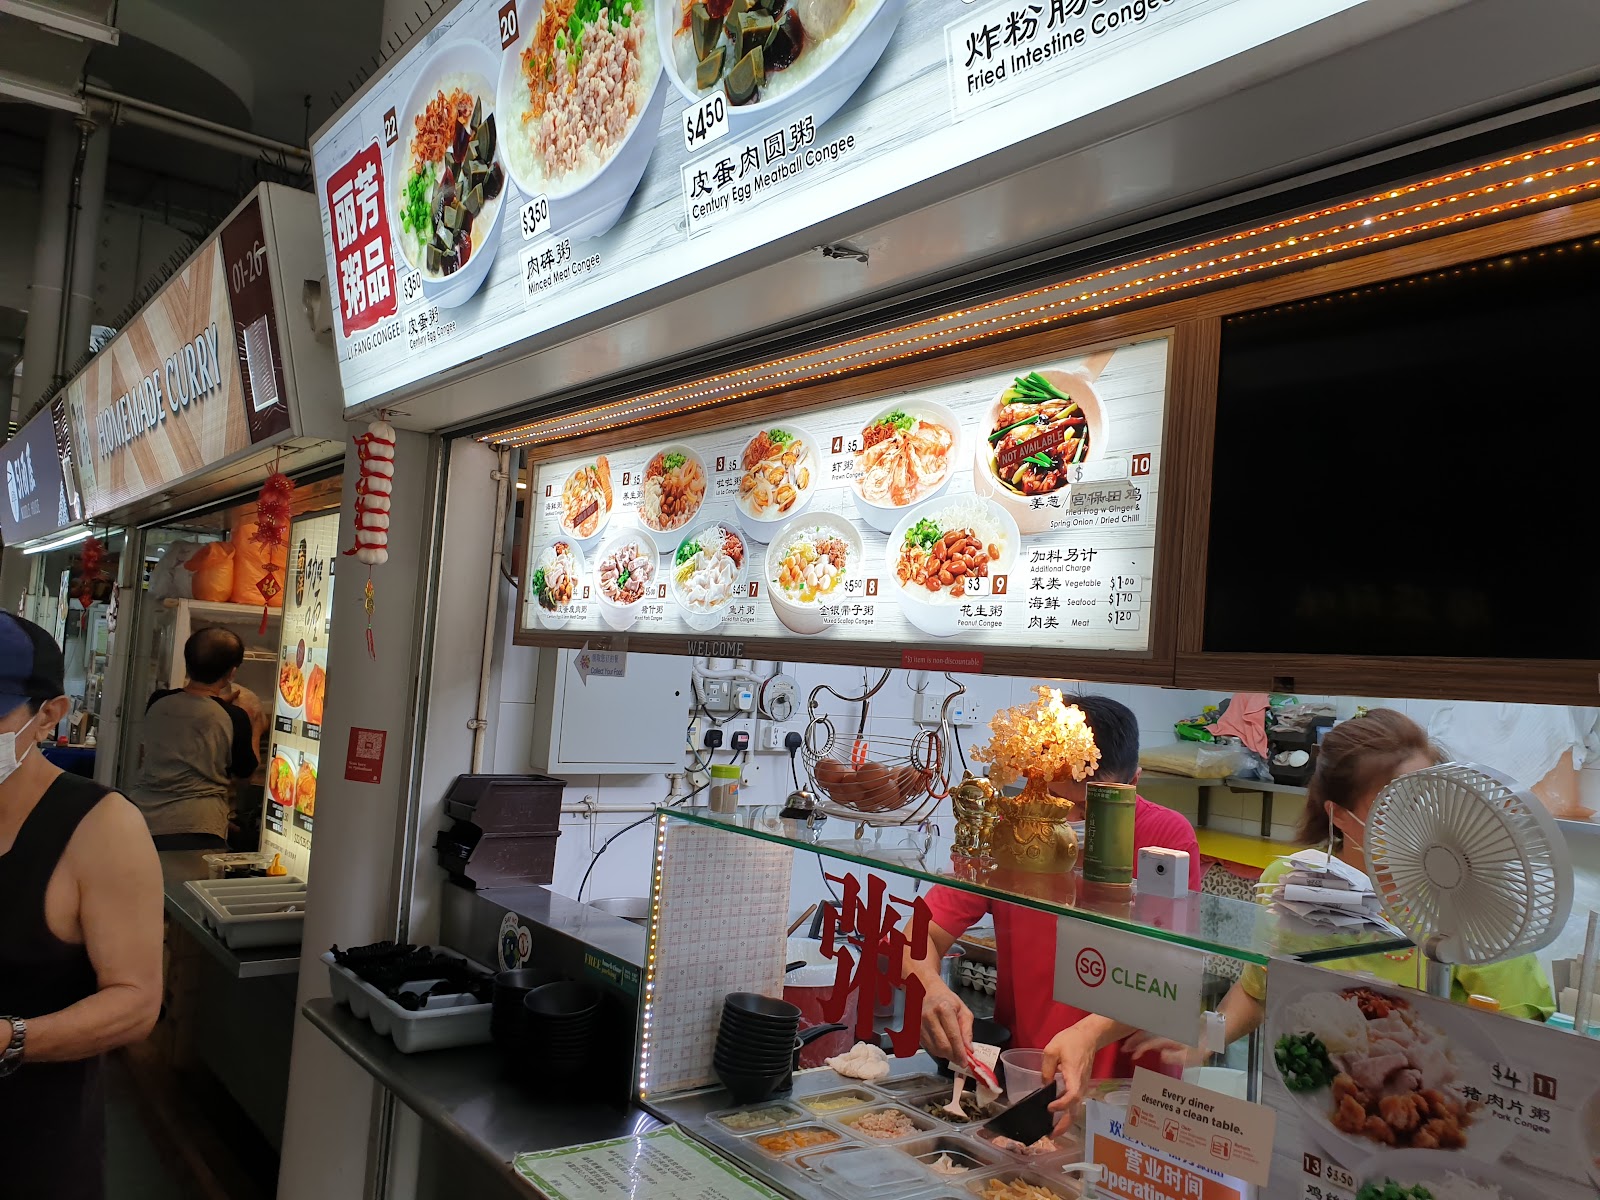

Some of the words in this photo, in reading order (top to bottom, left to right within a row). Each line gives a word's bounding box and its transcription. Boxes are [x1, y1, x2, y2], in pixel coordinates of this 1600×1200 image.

[501, 10, 517, 42] 20
[965, 0, 1101, 68] 炸粉肠
[967, 59, 1005, 93] Fried
[1010, 28, 1085, 75] Intestine
[1091, 0, 1174, 34] Conge
[385, 116, 397, 141] 22
[691, 115, 815, 198] 皮蛋肉圆粥
[692, 193, 729, 219] Century
[732, 185, 751, 204] Egg
[754, 158, 802, 193] Meatball
[805, 134, 855, 167] Congee
[332, 161, 379, 251] 丽芳
[233, 240, 263, 293] 01-26
[527, 239, 571, 280] 肉碎粥
[341, 236, 391, 319] 粥品
[528, 274, 552, 295] Minced
[553, 267, 570, 283] Meat
[571, 253, 601, 275] Congee
[408, 306, 439, 335] 皮蛋粥
[409, 333, 427, 349] Century
[427, 328, 437, 343] Egg
[436, 321, 456, 338] Congee
[96, 367, 166, 459] HOMEMADE
[165, 322, 222, 412] CURRY
[833, 438, 841, 452] 4
[847, 439, 858, 452] $5
[1001, 451, 1018, 465] NOT
[1019, 429, 1064, 457] AVAILABLE
[717, 457, 724, 470] 3
[729, 459, 737, 470] $5
[832, 460, 854, 472] 虾粥
[1133, 457, 1150, 473] 10
[623, 473, 630, 485] 2
[634, 474, 641, 485] $5
[1065, 508, 1082, 516] Fried
[1083, 507, 1099, 516] Frog
[1108, 504, 1134, 514] Ginger
[1050, 520, 1071, 528] Spring
[1073, 518, 1093, 526] Onion
[1101, 516, 1120, 524] Dried
[1121, 514, 1140, 523] Chilli
[1030, 548, 1098, 564] 加料另计
[1030, 564, 1064, 573] Additional
[1065, 564, 1091, 573] Charge
[583, 586, 589, 598] 5
[659, 585, 665, 597] 6
[751, 583, 757, 596] 7
[867, 581, 876, 595] 8
[968, 577, 980, 591] $3
[996, 577, 1005, 592] 9
[1029, 577, 1061, 590] 菜类
[1065, 579, 1101, 588] Vegetable
[960, 605, 1003, 617] 花生粥
[1028, 596, 1061, 610] 海鲜
[1067, 598, 1096, 606] Seafood
[855, 618, 874, 626] Congee
[957, 619, 978, 627] Peanut
[978, 619, 1003, 628] Congee
[1027, 615, 1060, 629] 肉类
[1071, 619, 1090, 627] Meat
[687, 640, 744, 657] WELCOME
[913, 655, 925, 663] item
[932, 657, 980, 666] non-discountable
[817, 870, 934, 1059] 粥
[1080, 957, 1102, 978] SG
[1111, 967, 1177, 1001] CLEAN
[1492, 1062, 1521, 1088] $4
[1538, 1077, 1554, 1095] 11
[1162, 1088, 1186, 1105] Every
[1188, 1097, 1215, 1113] diner
[1462, 1085, 1551, 1123] 猪肉片粥
[1141, 1094, 1174, 1112] deserves
[1175, 1107, 1181, 1115] a
[1183, 1109, 1209, 1124] clean
[1212, 1117, 1244, 1136] table.
[1492, 1109, 1511, 1123] Pork
[1513, 1115, 1551, 1135] Congee
[1305, 1156, 1320, 1174] 13
[1125, 1148, 1203, 1200] 营业时间
[1326, 1165, 1354, 1187] $3.50
